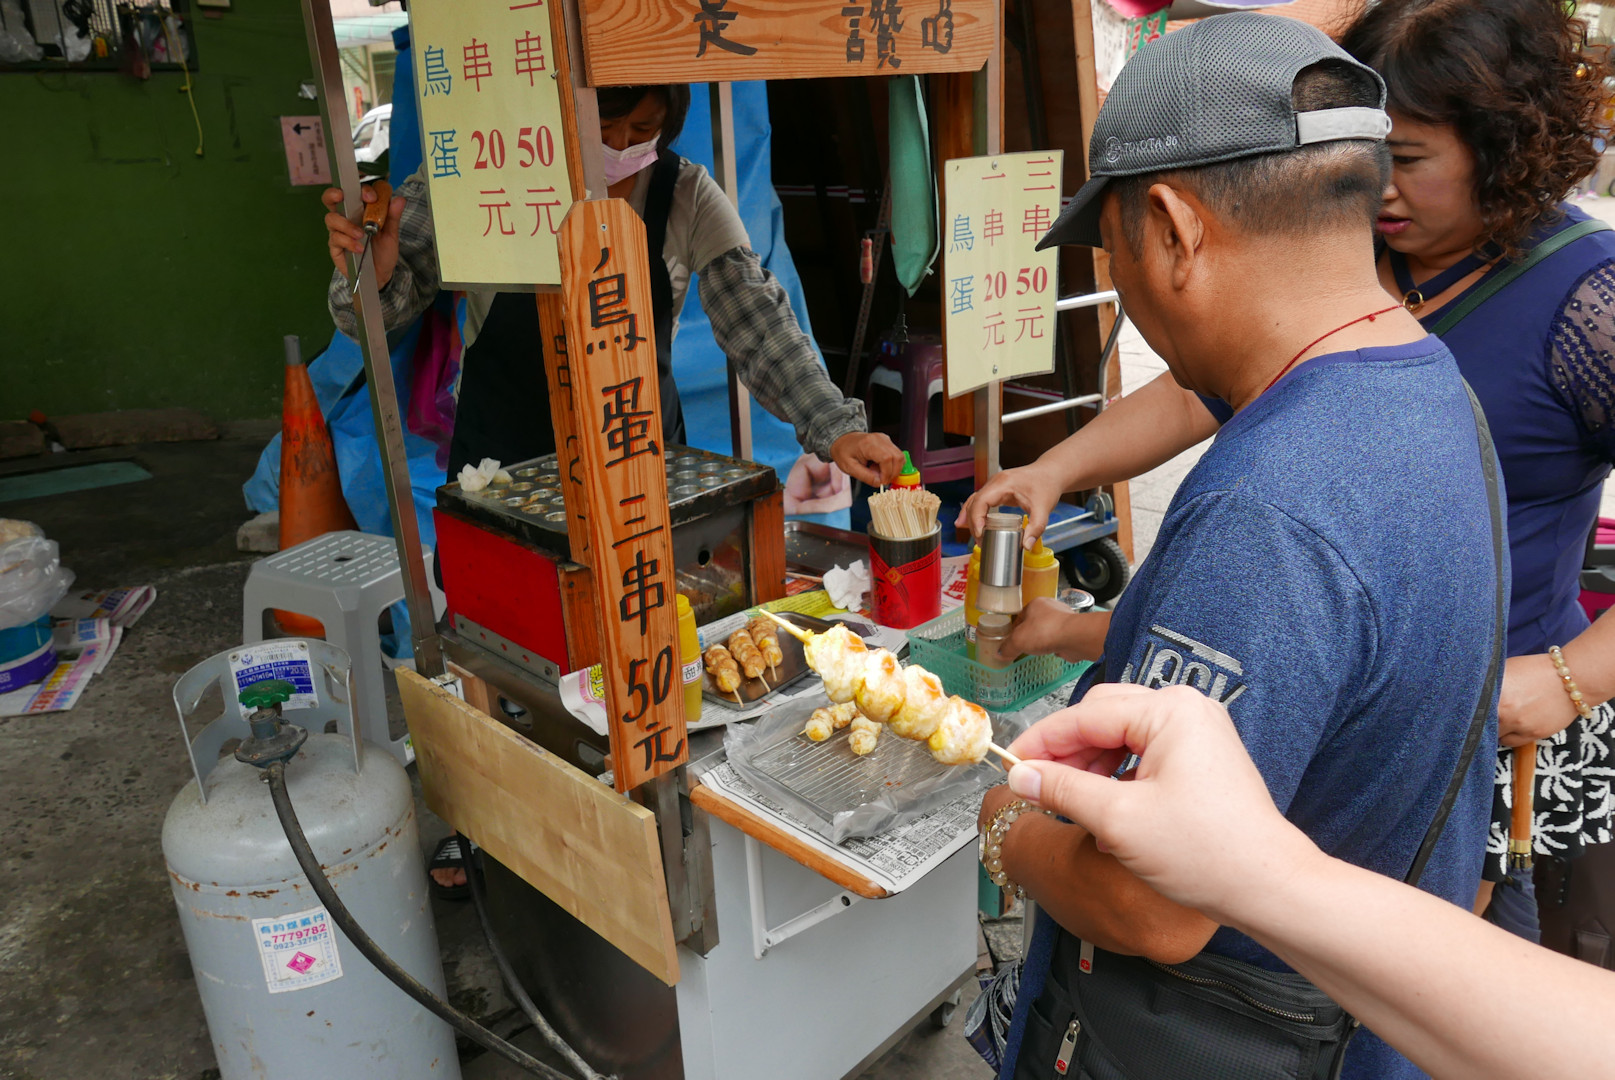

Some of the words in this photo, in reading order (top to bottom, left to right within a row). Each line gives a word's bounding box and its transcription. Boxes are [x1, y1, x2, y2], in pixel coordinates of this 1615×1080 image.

[424, 45, 461, 180] 鳥蛋
[1122, 138, 1162, 153] TOYOTA
[950, 214, 974, 315] 鳥蛋
[272, 923, 327, 943] 7779782
